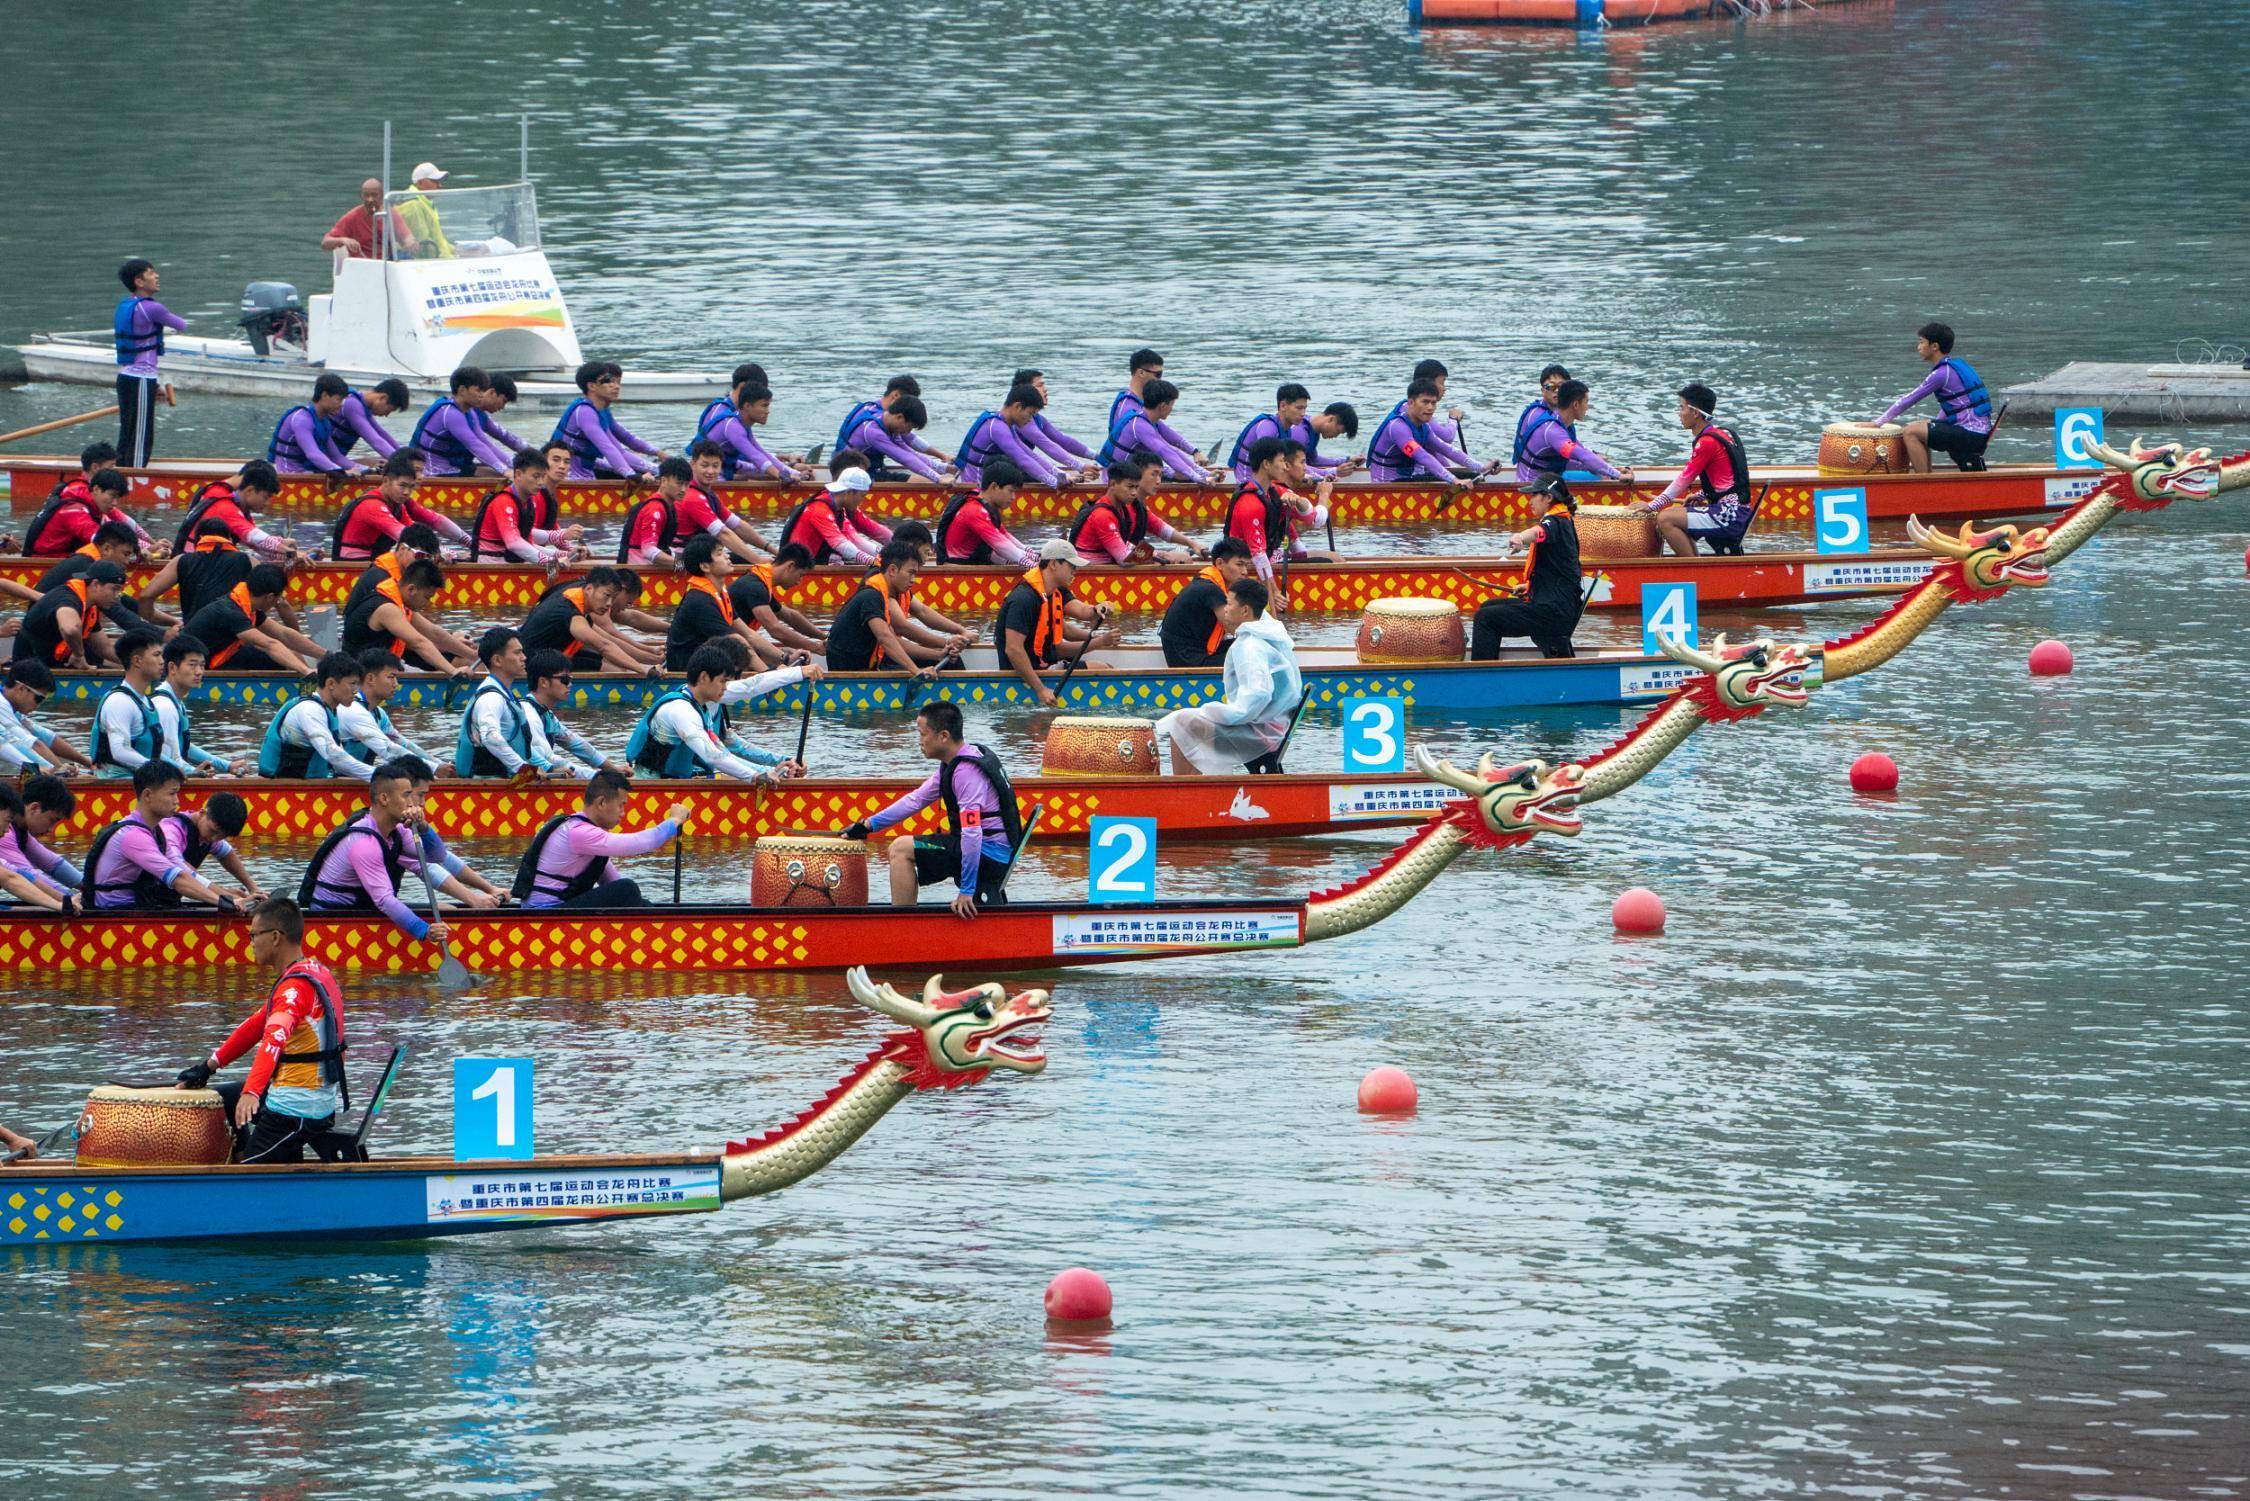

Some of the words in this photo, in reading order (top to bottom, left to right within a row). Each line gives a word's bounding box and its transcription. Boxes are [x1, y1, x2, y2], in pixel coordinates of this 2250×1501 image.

[2061, 413, 2097, 461] 6
[1823, 495, 1859, 545] 5
[1648, 589, 1691, 644] 4
[1351, 703, 1395, 764] 3
[966, 813, 976, 825] C
[1097, 824, 1146, 891] 2
[1080, 932, 1270, 943] 暨重庆市第四届龙舟公开赛总决赛
[1091, 920, 1259, 931] 重庆市第七届运动会龙舟比赛
[473, 1068, 514, 1145] 1
[460, 1191, 684, 1209] 暨重庆市第四届龙舟公开赛总决赛
[472, 1177, 671, 1194] 重庆市第七届运动会龙舟比赛
